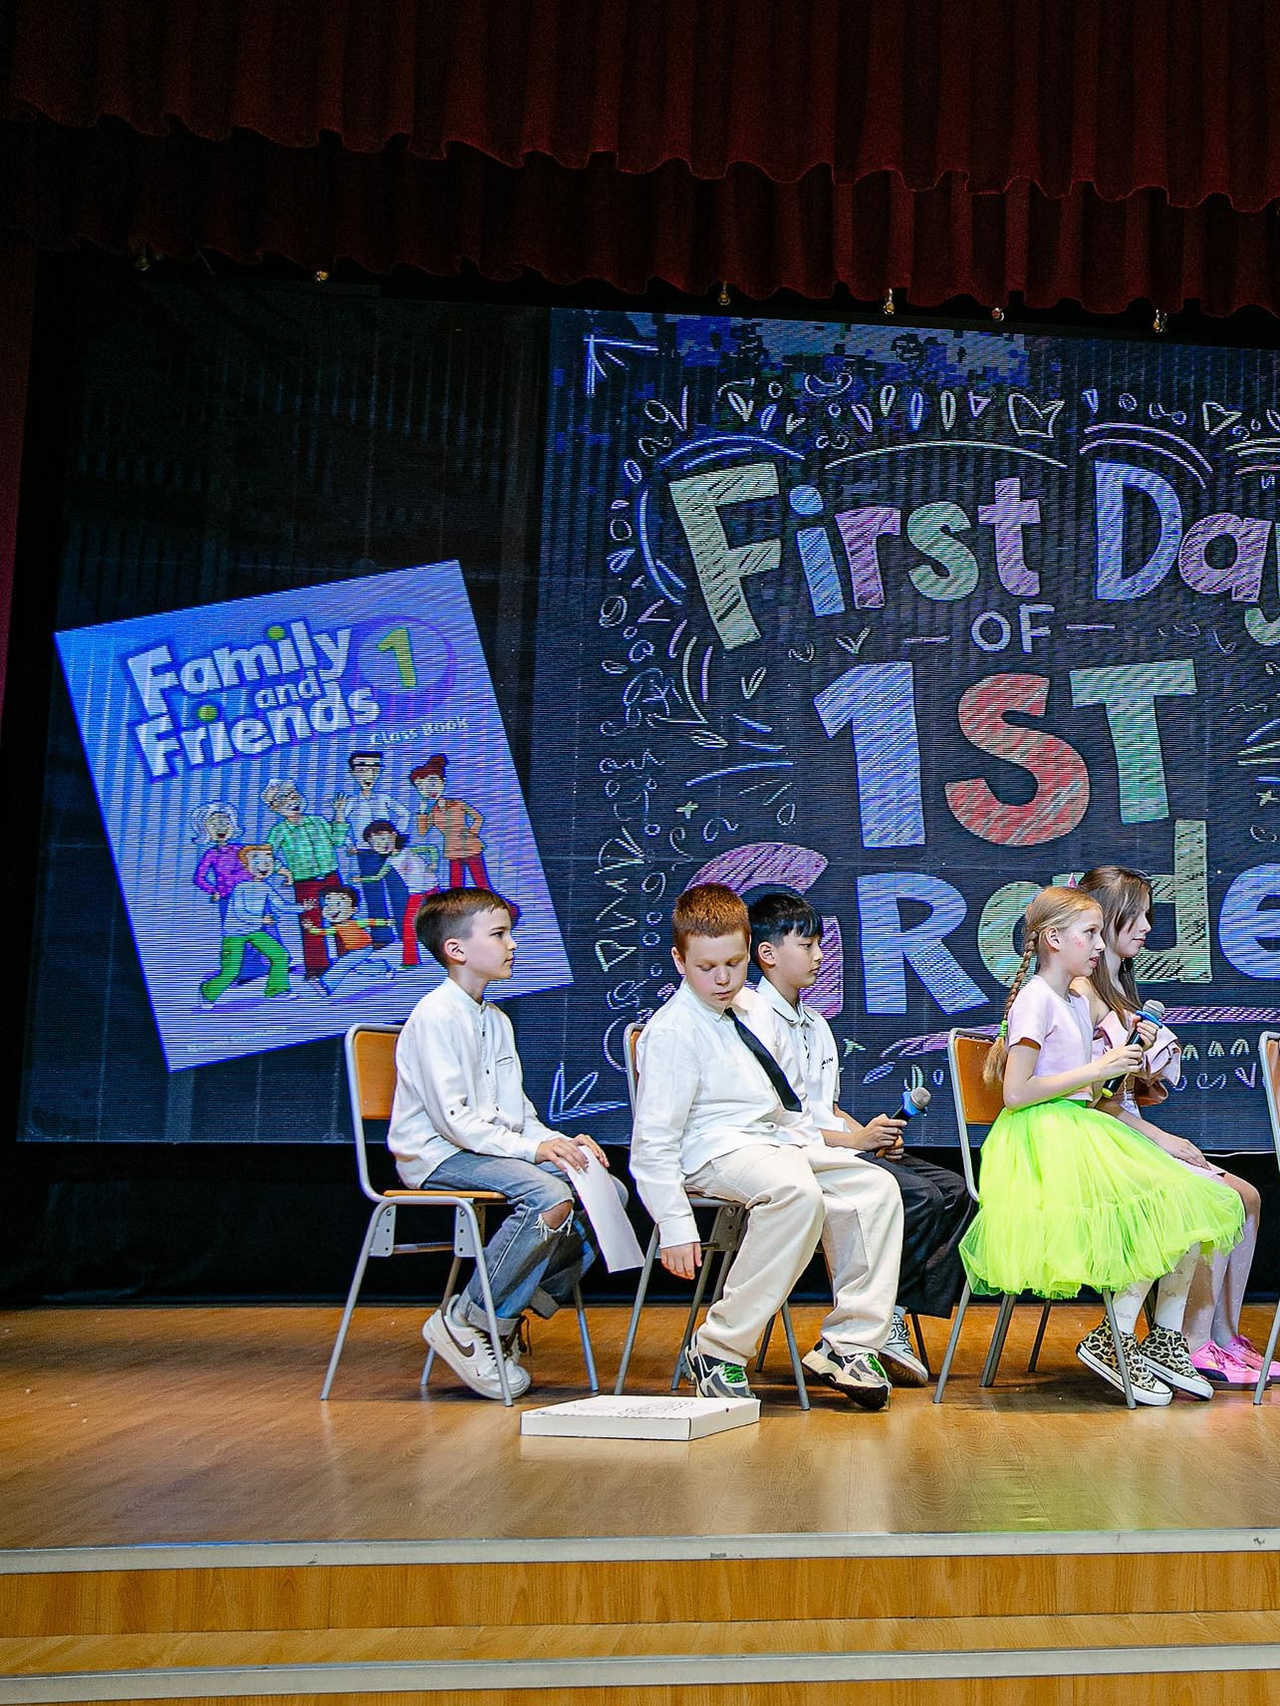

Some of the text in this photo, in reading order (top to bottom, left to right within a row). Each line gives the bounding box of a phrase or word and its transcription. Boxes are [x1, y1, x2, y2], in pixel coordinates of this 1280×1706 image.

[668, 462, 1041, 650] First
[127, 620, 351, 717] Family
[377, 627, 417, 688] 1
[971, 603, 1055, 653] OF
[135, 680, 381, 776] Friends
[254, 671, 321, 709] and
[813, 658, 1198, 848] 1ST
